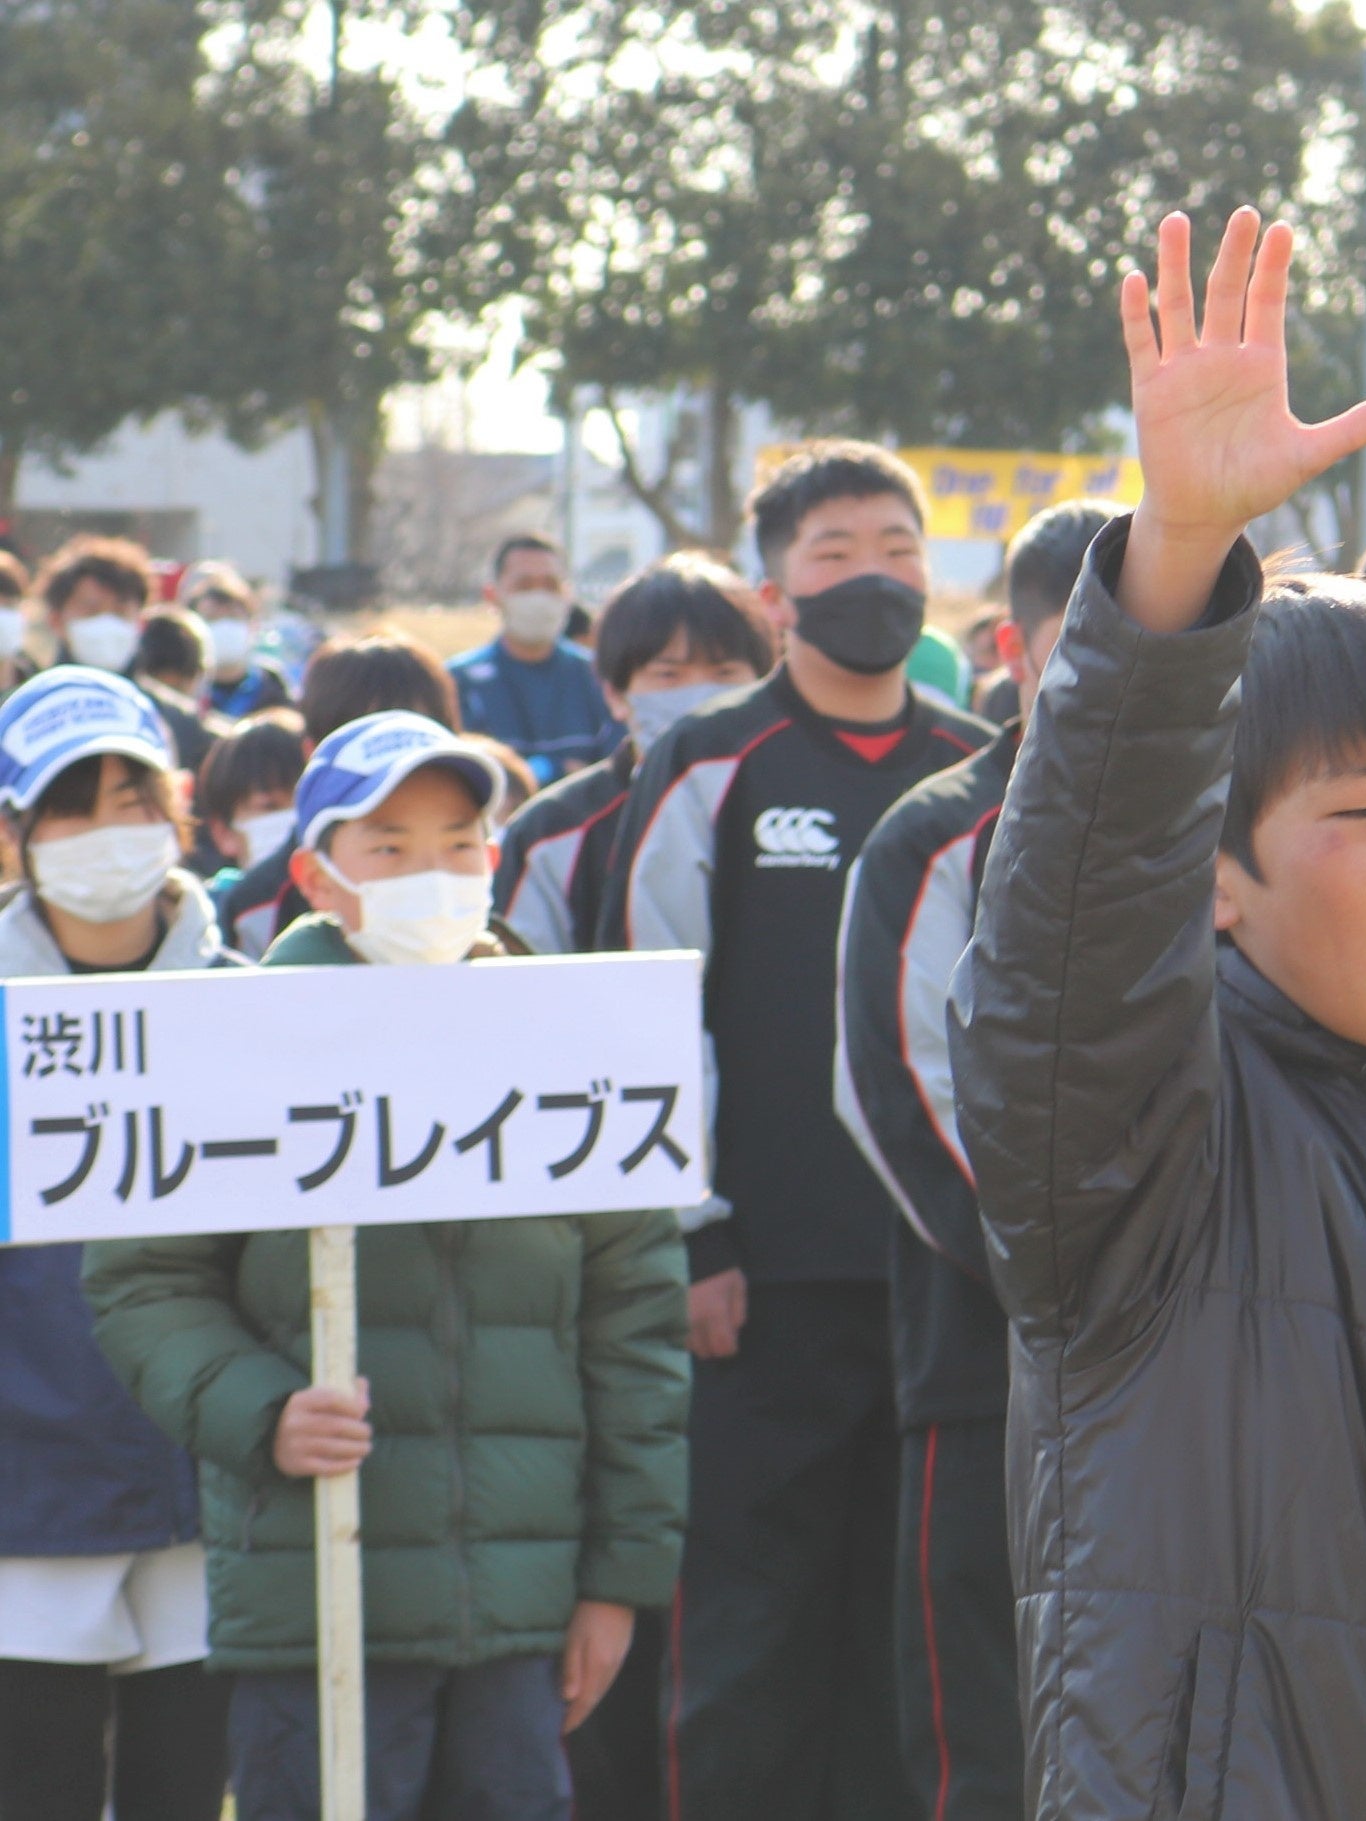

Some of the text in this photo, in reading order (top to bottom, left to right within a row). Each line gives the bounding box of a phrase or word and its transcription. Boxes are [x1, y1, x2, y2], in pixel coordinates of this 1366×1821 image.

[21, 1009, 147, 1077] 渋川
[30, 1079, 691, 1206] ブルーブレイブス
